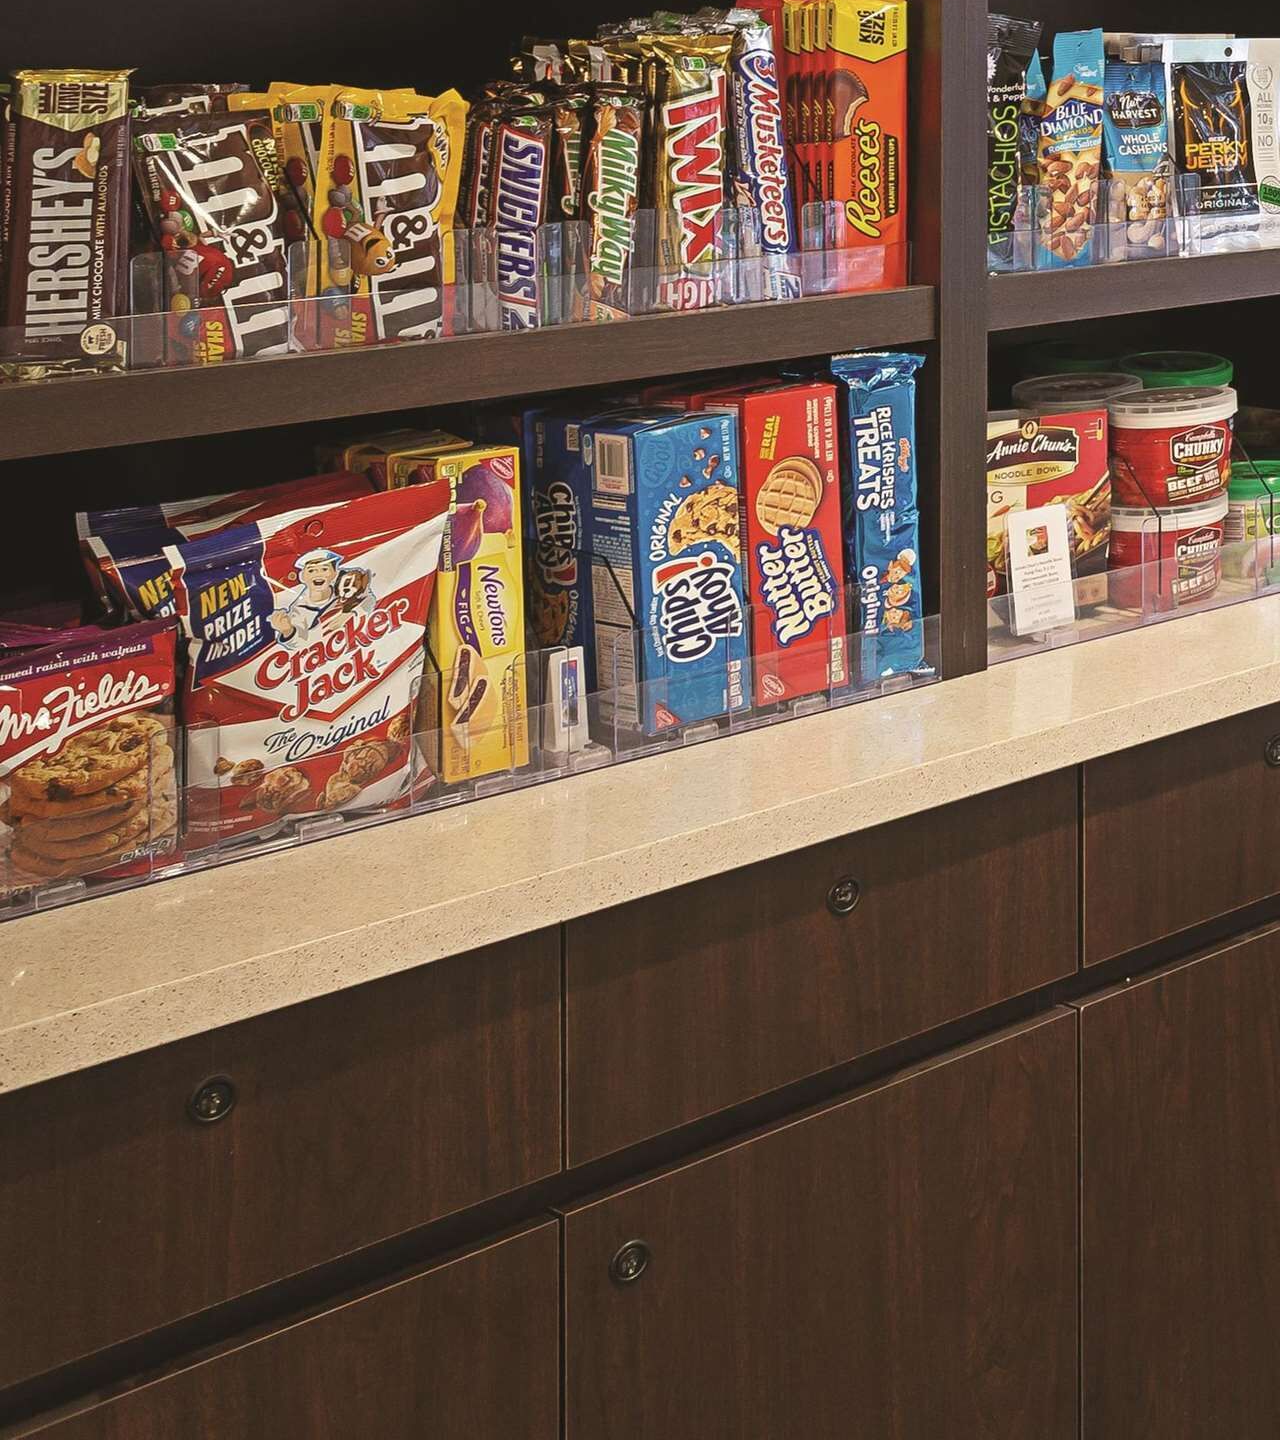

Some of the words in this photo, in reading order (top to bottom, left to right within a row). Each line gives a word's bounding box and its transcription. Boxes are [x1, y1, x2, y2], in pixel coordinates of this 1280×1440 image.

[859, 11, 870, 43] KING
[871, 11, 886, 46] SIZE
[753, 56, 776, 81] 3
[57, 83, 81, 113] KING
[81, 83, 109, 114] SIZE
[1055, 102, 1087, 120] BLUE
[1112, 109, 1158, 119] HARVEST
[1040, 109, 1104, 136] DIAMOND
[1121, 133, 1160, 144] WHOLE
[252, 138, 277, 191] CHOCOLATE
[667, 74, 727, 264] TWIX
[750, 82, 788, 246] Musketeers
[1119, 143, 1168, 155] CASHEWS
[1185, 140, 1248, 157] PERKY
[1186, 154, 1248, 169] JERKY
[97, 165, 109, 212] ALMONDS
[846, 120, 881, 238] Reese's
[96, 216, 105, 238] WITH
[499, 134, 544, 299] SNICKERS
[25, 147, 94, 337] HERSHEY'S
[94, 239, 105, 296] CHOCOLATE
[93, 298, 101, 320] MILK
[876, 406, 891, 440] RICE
[853, 411, 882, 510] TREATS
[986, 439, 1029, 462] Annie
[1030, 435, 1076, 454] Chun's
[1173, 439, 1225, 459] CHUNKY
[878, 441, 896, 510] KRISPIES
[994, 467, 1033, 481] NOODLE
[1036, 465, 1062, 475] BOWL
[1168, 475, 1201, 492] BEEF
[651, 493, 682, 560] ORIGINAL
[200, 572, 249, 619] NEW
[760, 544, 810, 645] Nutter
[781, 528, 835, 620] Butter
[204, 596, 253, 641] PRIZE
[458, 602, 470, 626] FIG
[477, 564, 506, 647] Newtons
[666, 578, 713, 660] Chips
[861, 565, 880, 636] Original
[36, 660, 70, 673] raisin
[73, 652, 98, 665] with
[101, 643, 147, 658] walnuts
[205, 617, 261, 663] INSIDE!
[254, 596, 411, 691] Cracker
[279, 646, 383, 723] Jack
[43, 670, 159, 753] Fields
[263, 727, 297, 753] The
[286, 695, 392, 762] Original
